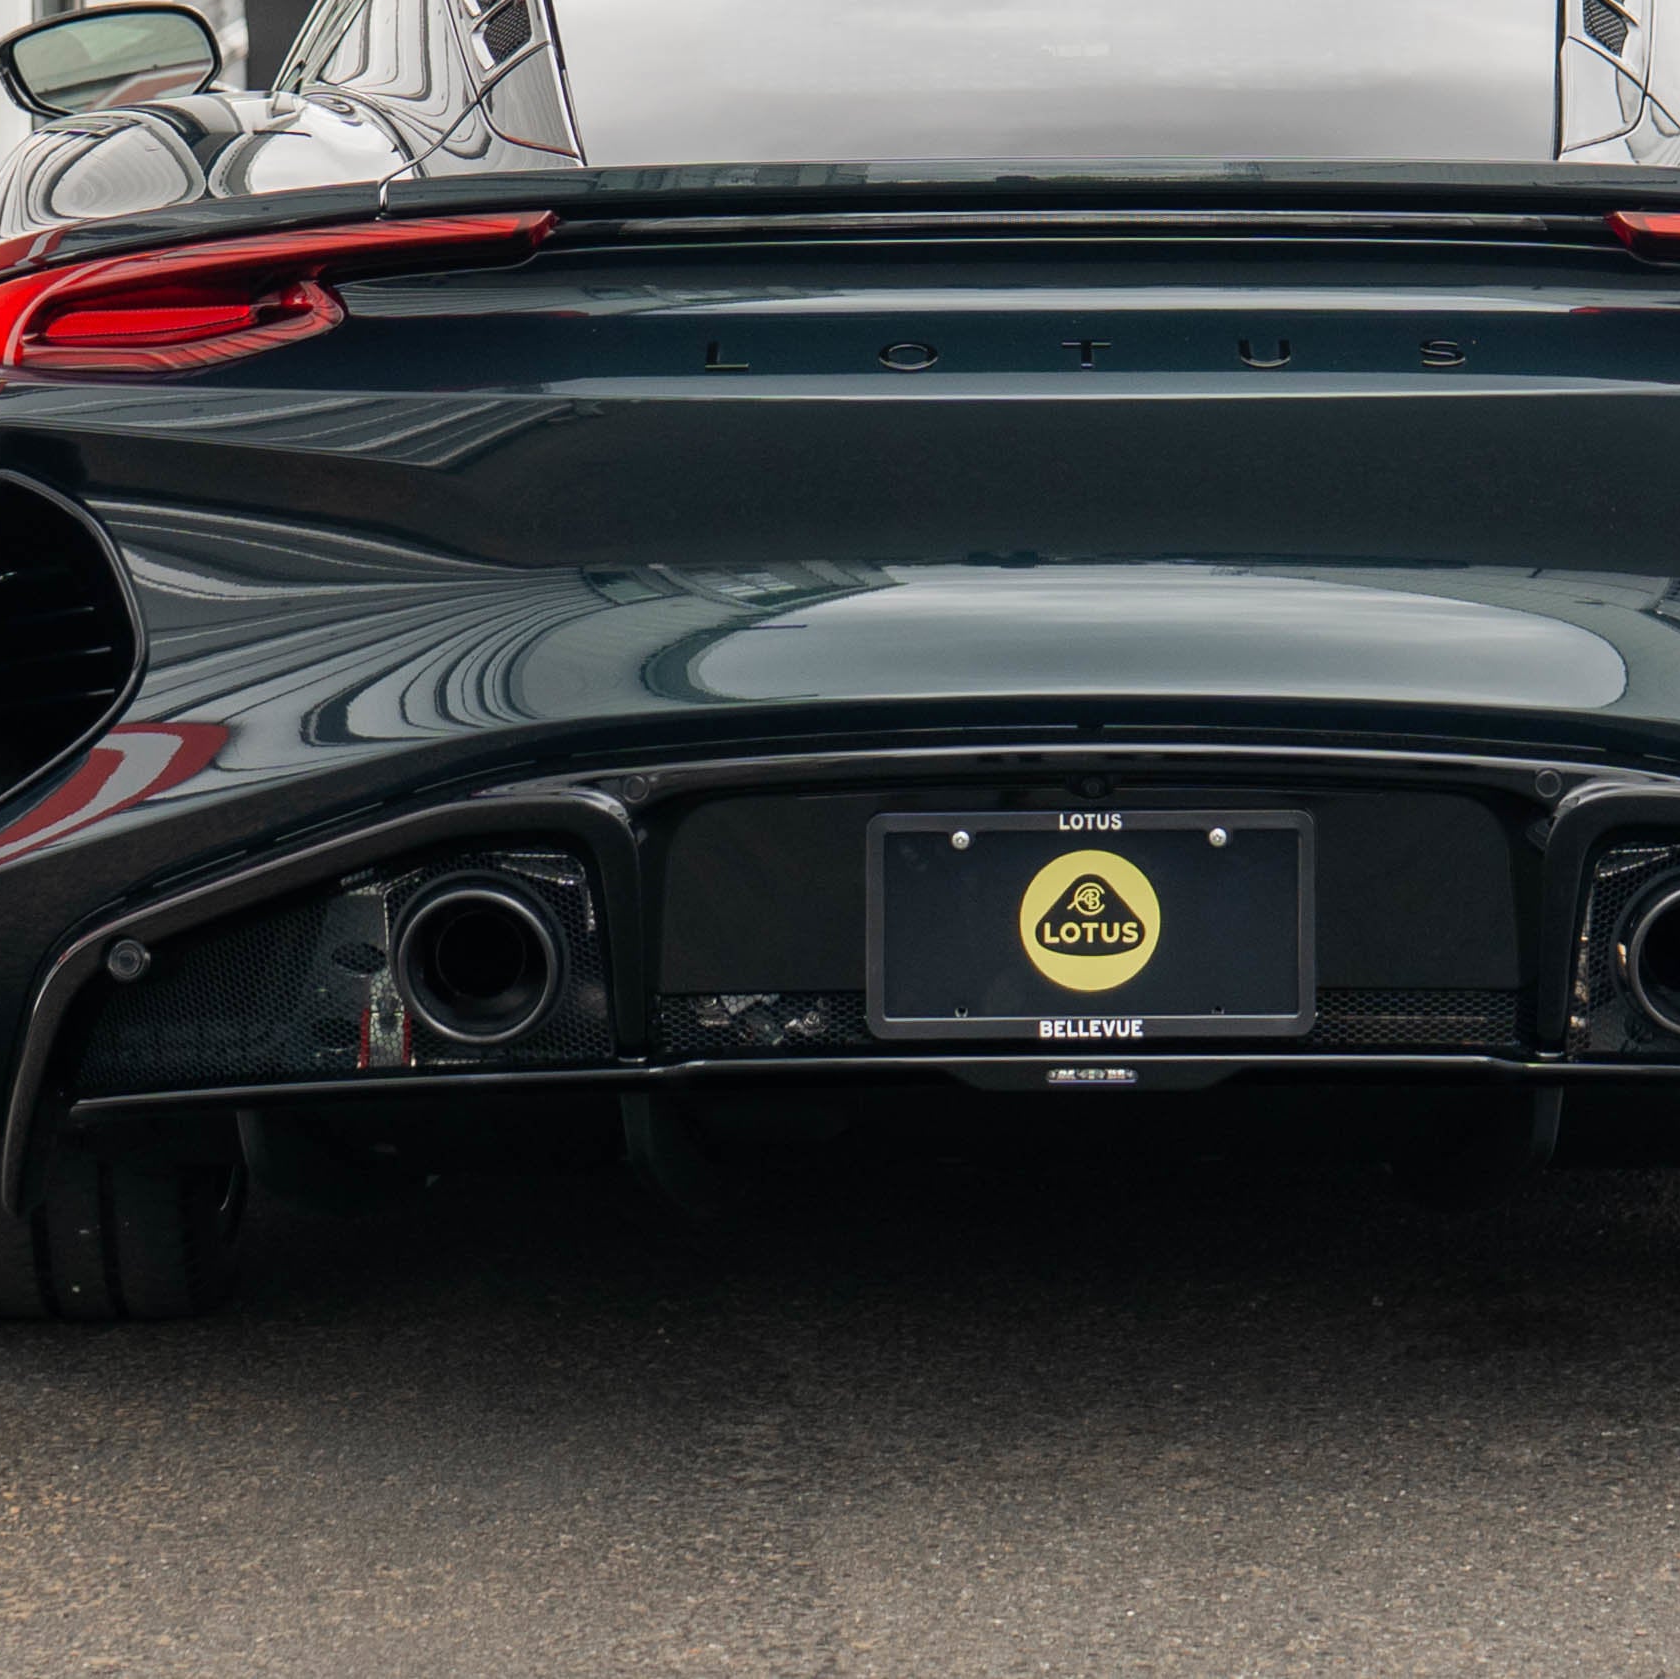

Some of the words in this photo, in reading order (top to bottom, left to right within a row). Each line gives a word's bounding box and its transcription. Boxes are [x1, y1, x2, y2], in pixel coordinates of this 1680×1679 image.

[704, 338, 1466, 373] LOTUS
[1059, 813, 1123, 831] LOTUS
[1043, 921, 1140, 944] LOTUS
[1039, 1019, 1144, 1038] BELLEVUE
